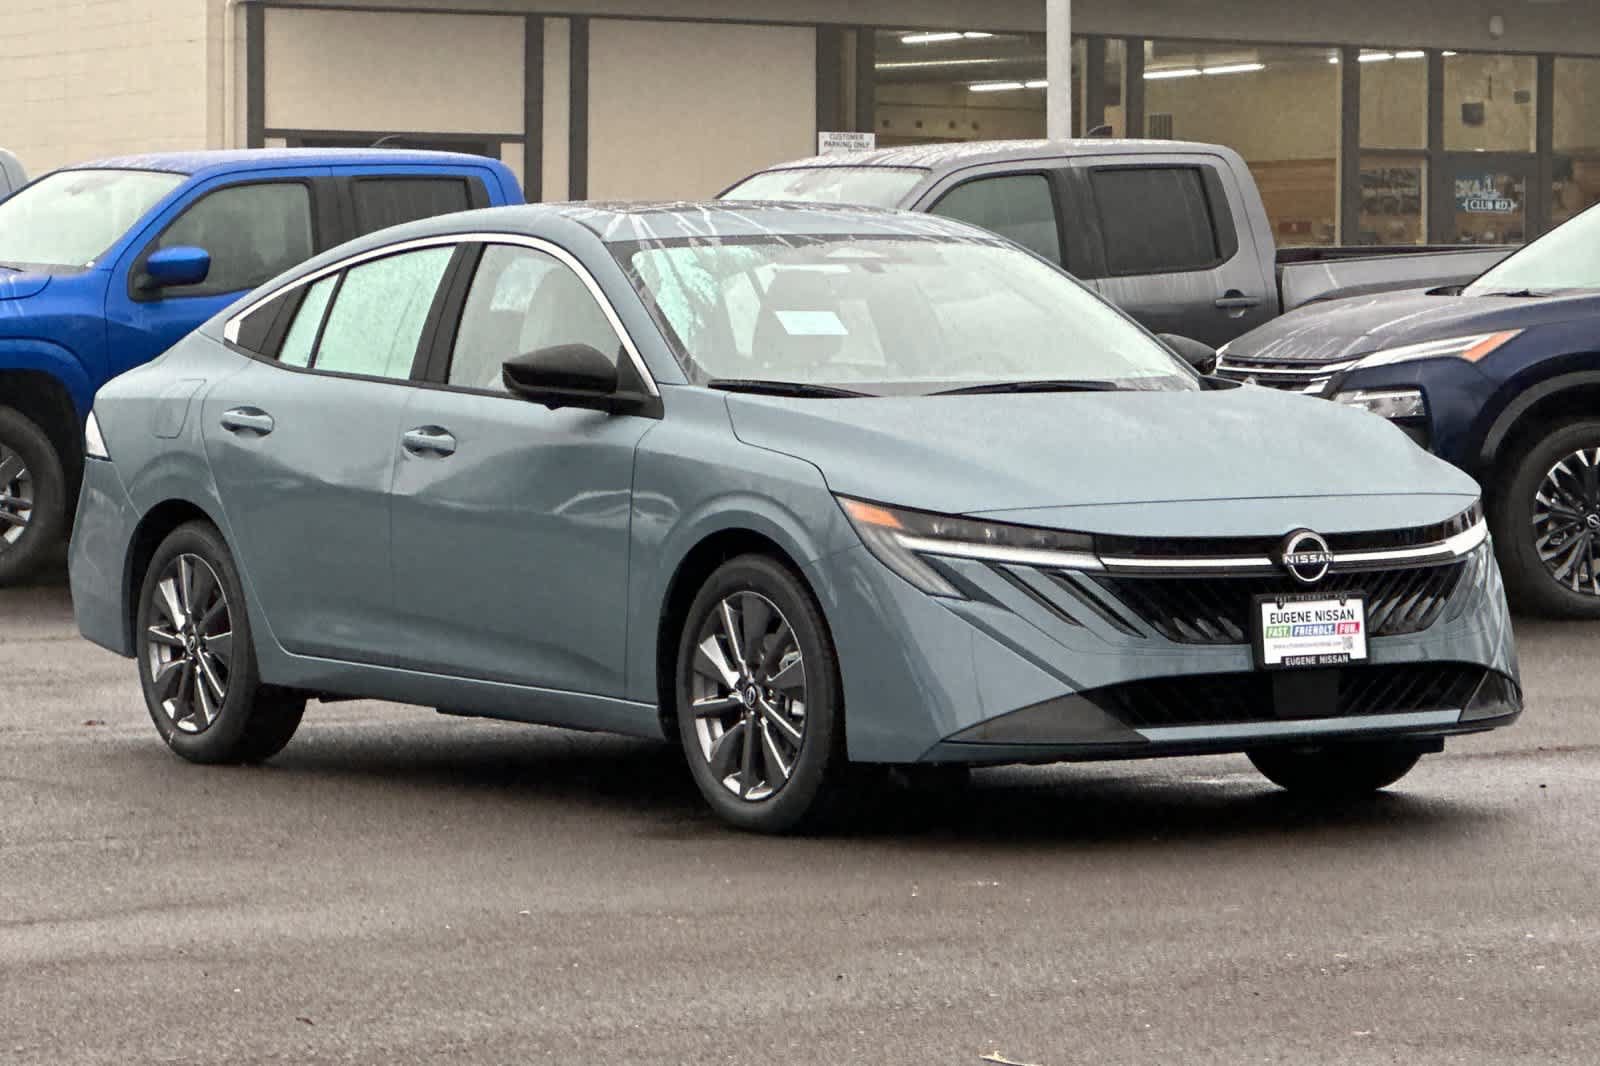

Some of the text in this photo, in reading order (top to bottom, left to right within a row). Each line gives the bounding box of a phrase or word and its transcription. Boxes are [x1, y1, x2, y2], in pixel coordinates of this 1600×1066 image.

[1283, 554, 1333, 564] NISSAN
[1270, 609, 1355, 625] EUGENE NISSAN
[1285, 654, 1349, 666] EUGENE NISSAN
